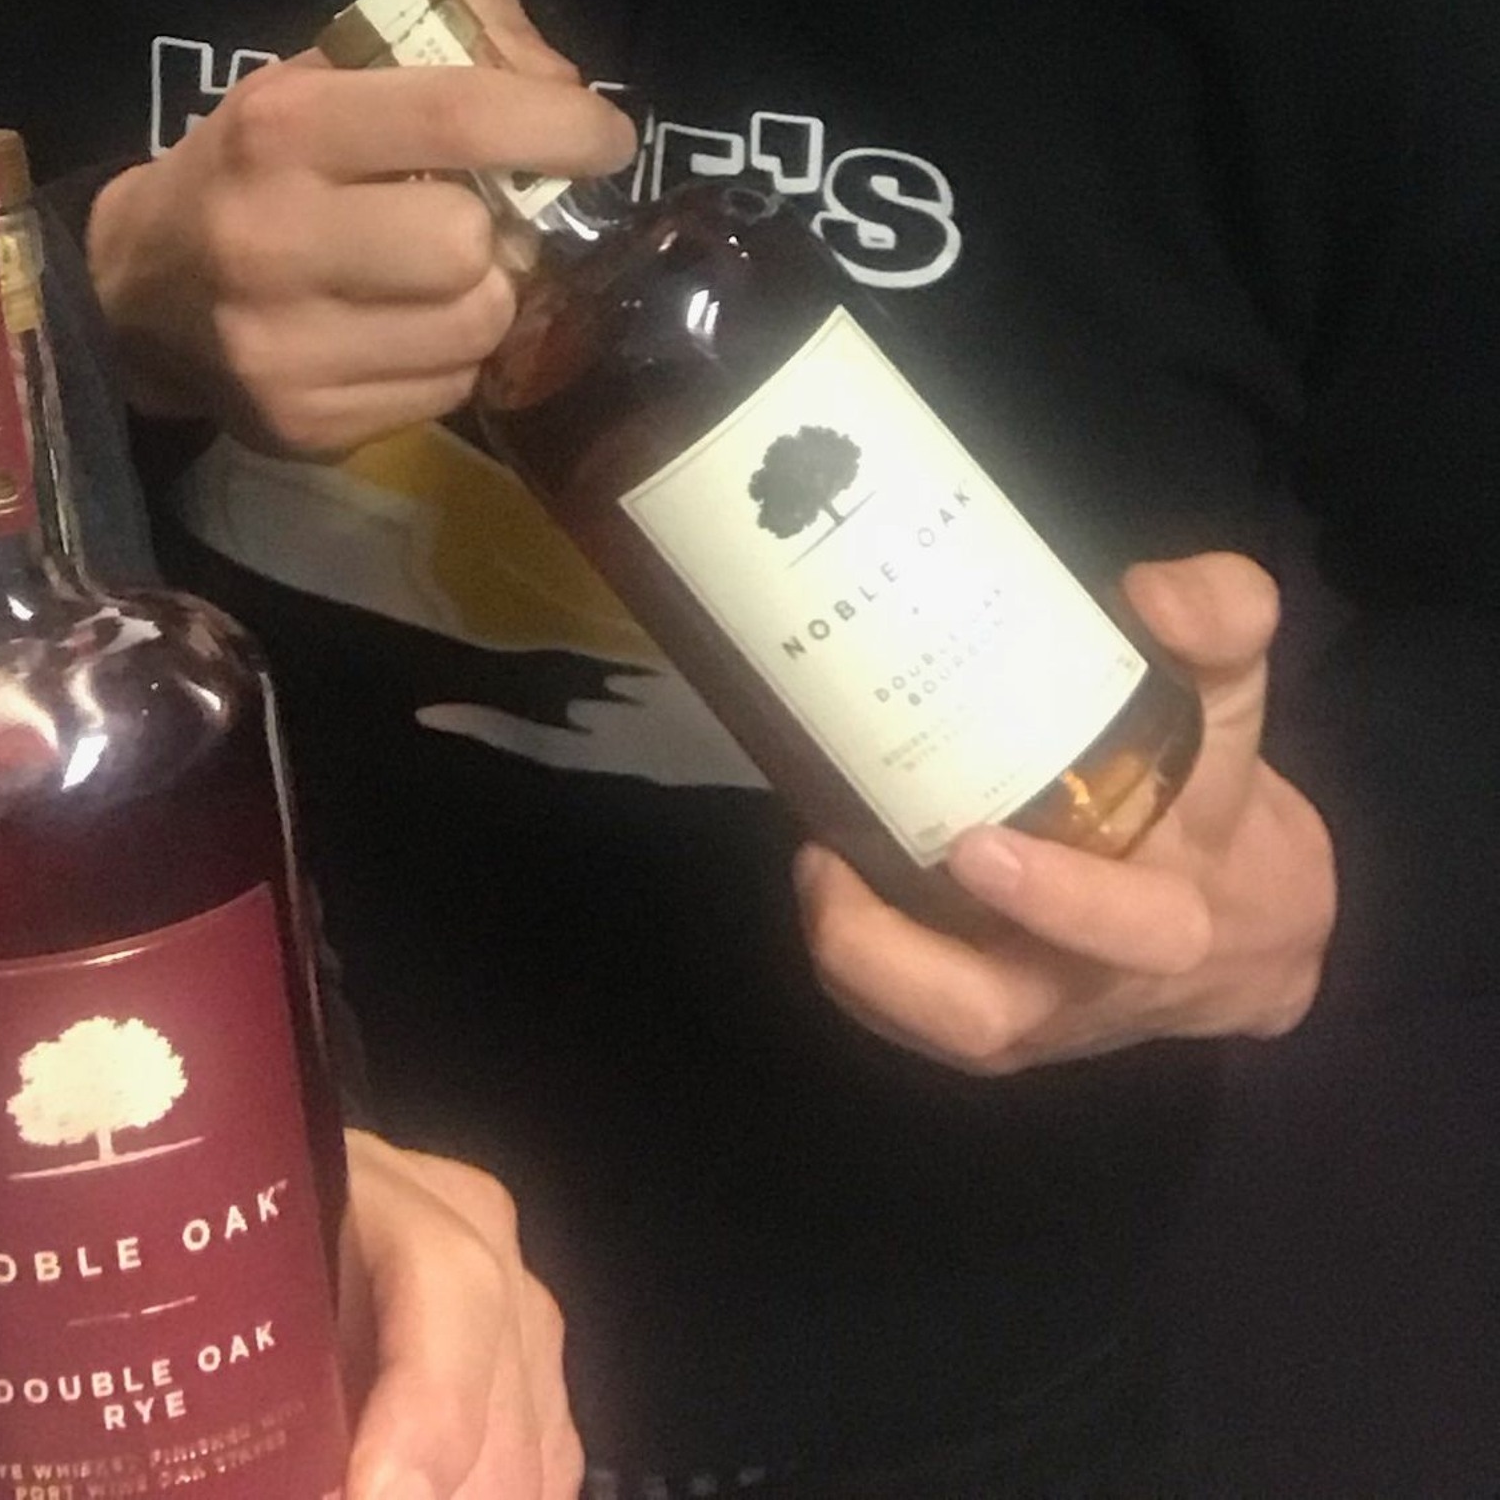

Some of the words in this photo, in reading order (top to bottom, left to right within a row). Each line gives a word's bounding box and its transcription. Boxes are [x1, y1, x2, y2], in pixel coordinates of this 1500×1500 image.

[781, 561, 899, 661] NOBLE
[916, 484, 971, 548] OAK
[874, 633, 958, 703] DOUB
[182, 1185, 279, 1252] OAK
[197, 1320, 276, 1373] OAK
[103, 1389, 187, 1431] RYE
